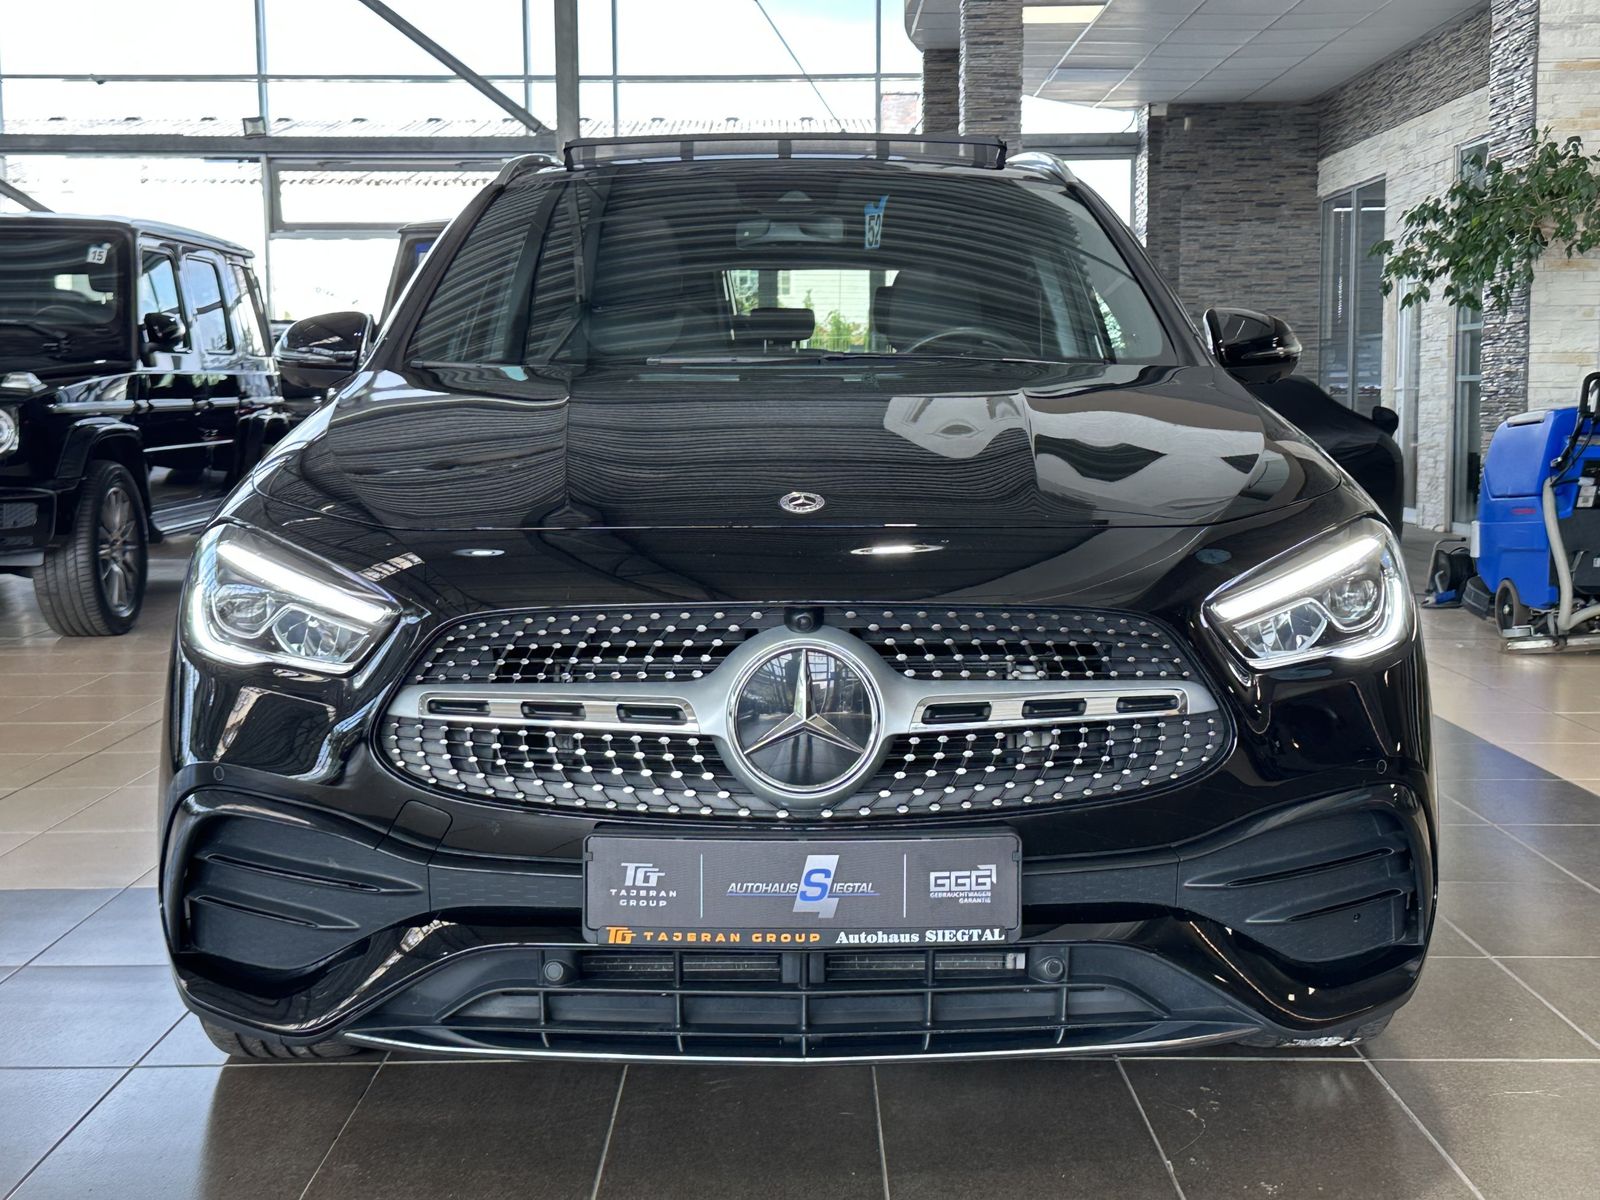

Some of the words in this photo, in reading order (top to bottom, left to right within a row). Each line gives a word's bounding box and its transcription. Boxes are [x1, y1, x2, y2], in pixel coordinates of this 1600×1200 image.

[867, 214, 881, 246] 52
[91, 250, 104, 261] 15
[929, 870, 991, 891] GGG
[609, 888, 677, 897] TAJERAN
[727, 882, 798, 893] AUTOHAUS
[619, 899, 667, 907] GROUP
[643, 931, 741, 943] TAJERAN
[751, 932, 821, 943] GROUP
[835, 930, 920, 944] Autohaus
[925, 928, 1006, 943] SIEGTAL
